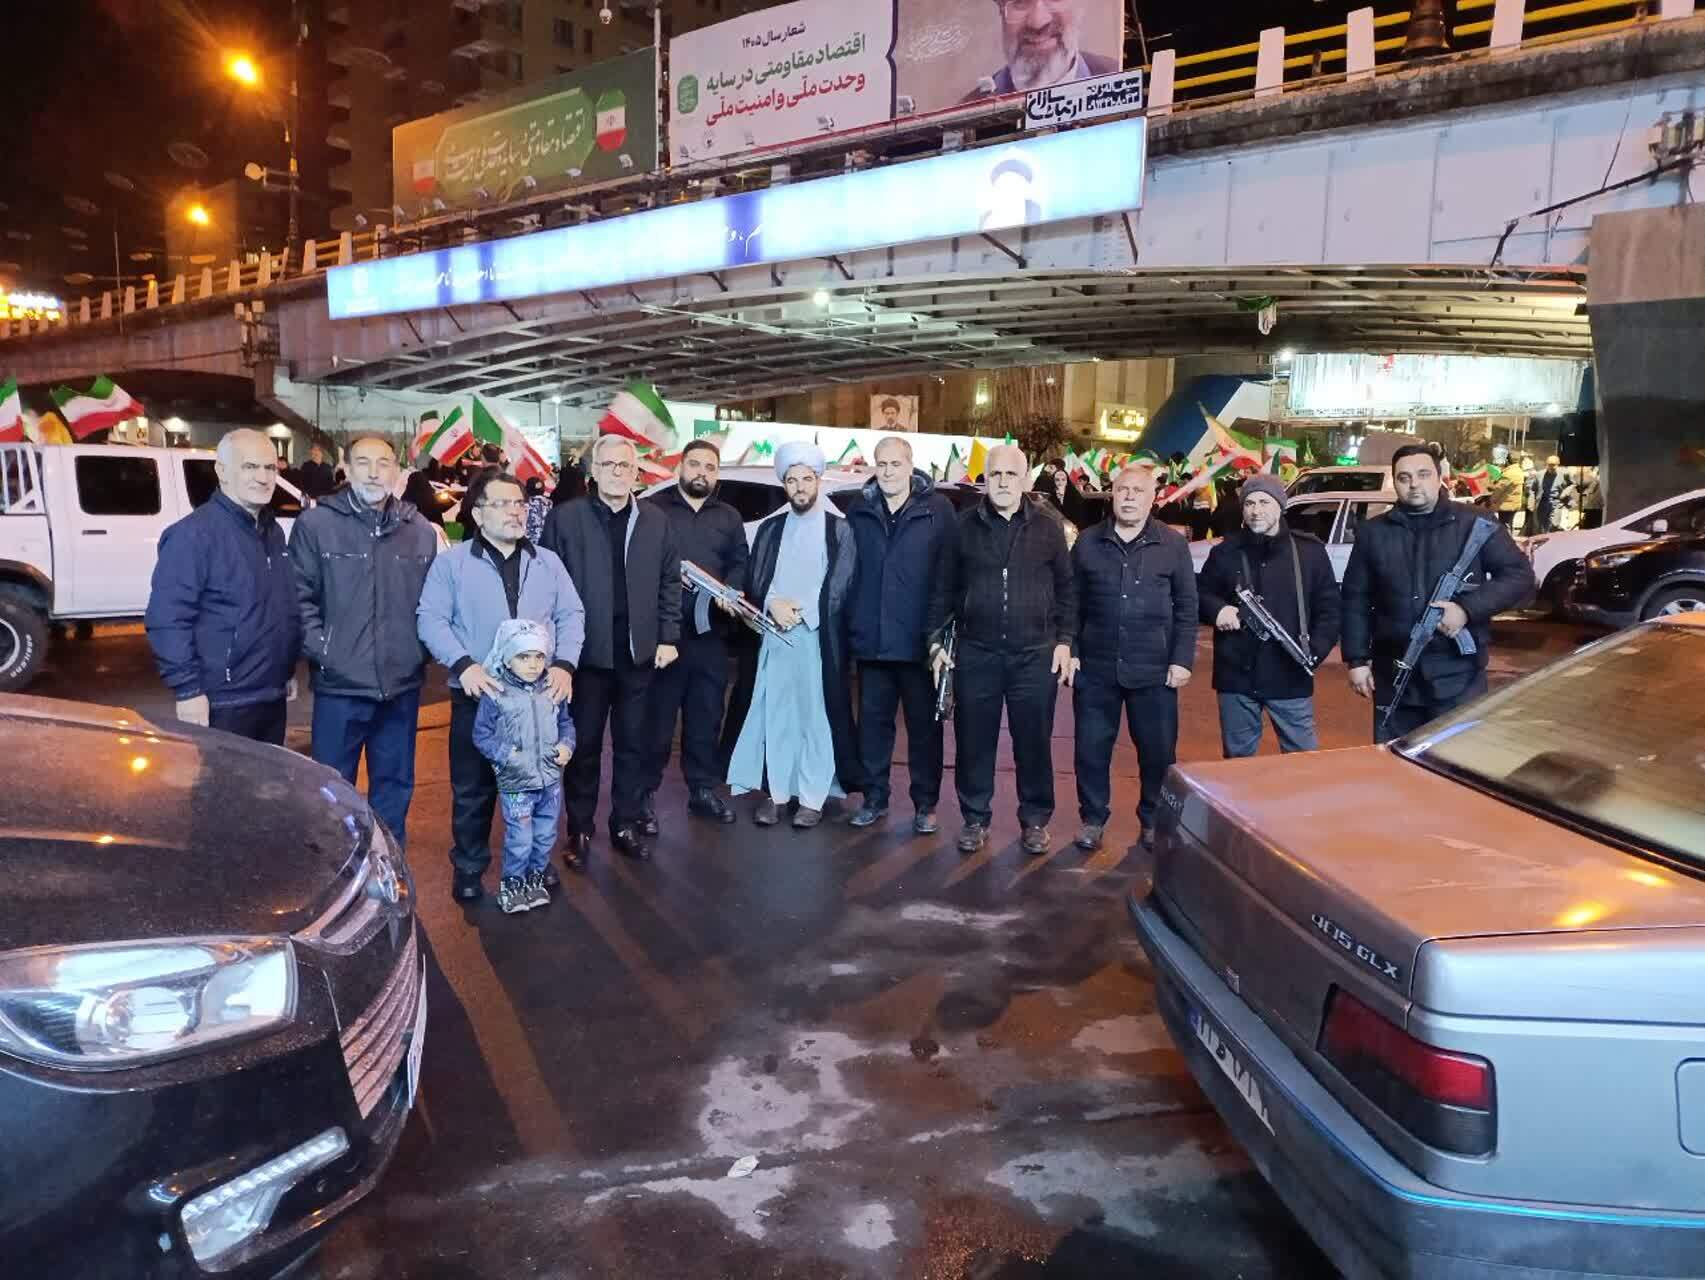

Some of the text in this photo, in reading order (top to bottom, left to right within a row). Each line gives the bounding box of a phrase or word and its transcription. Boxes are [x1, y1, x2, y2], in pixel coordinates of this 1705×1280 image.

[742, 22, 806, 49] شعار سال ۱۴۰۵
[815, 32, 866, 64] اقتصاد
[736, 67, 753, 90] در
[755, 51, 814, 85] مقاومتی
[706, 71, 736, 96] سایه
[819, 71, 866, 94] وحدت
[735, 88, 775, 116] امنیت
[1357, 944, 1398, 979] GLX
